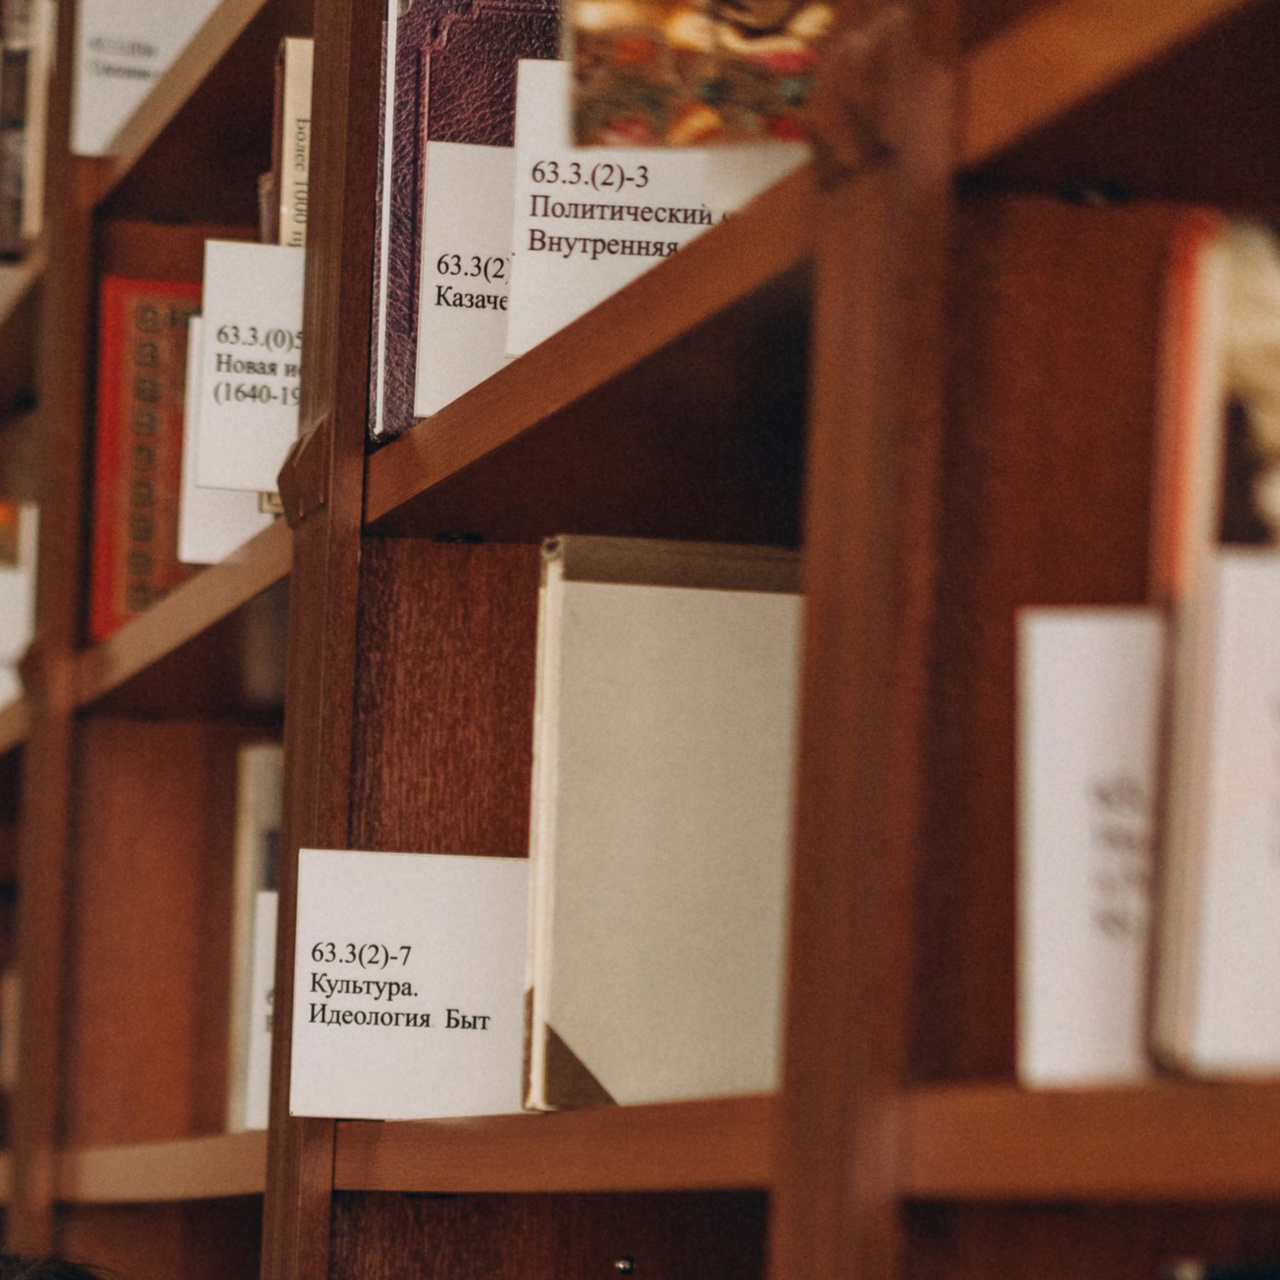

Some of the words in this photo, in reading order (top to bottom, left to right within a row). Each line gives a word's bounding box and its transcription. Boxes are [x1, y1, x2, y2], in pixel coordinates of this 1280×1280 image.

[531, 160, 650, 192] 63.3.(2)-3
[529, 194, 714, 226] Политический
[528, 229, 680, 260] Внутренняя
[435, 284, 508, 311] Казаче
[215, 353, 278, 377] Новая
[284, 363, 301, 378] и
[310, 941, 412, 970] 63.3(2)-7
[309, 972, 419, 1001] Культура.
[308, 1002, 431, 1028] Идеология
[444, 1008, 491, 1031] Быт
